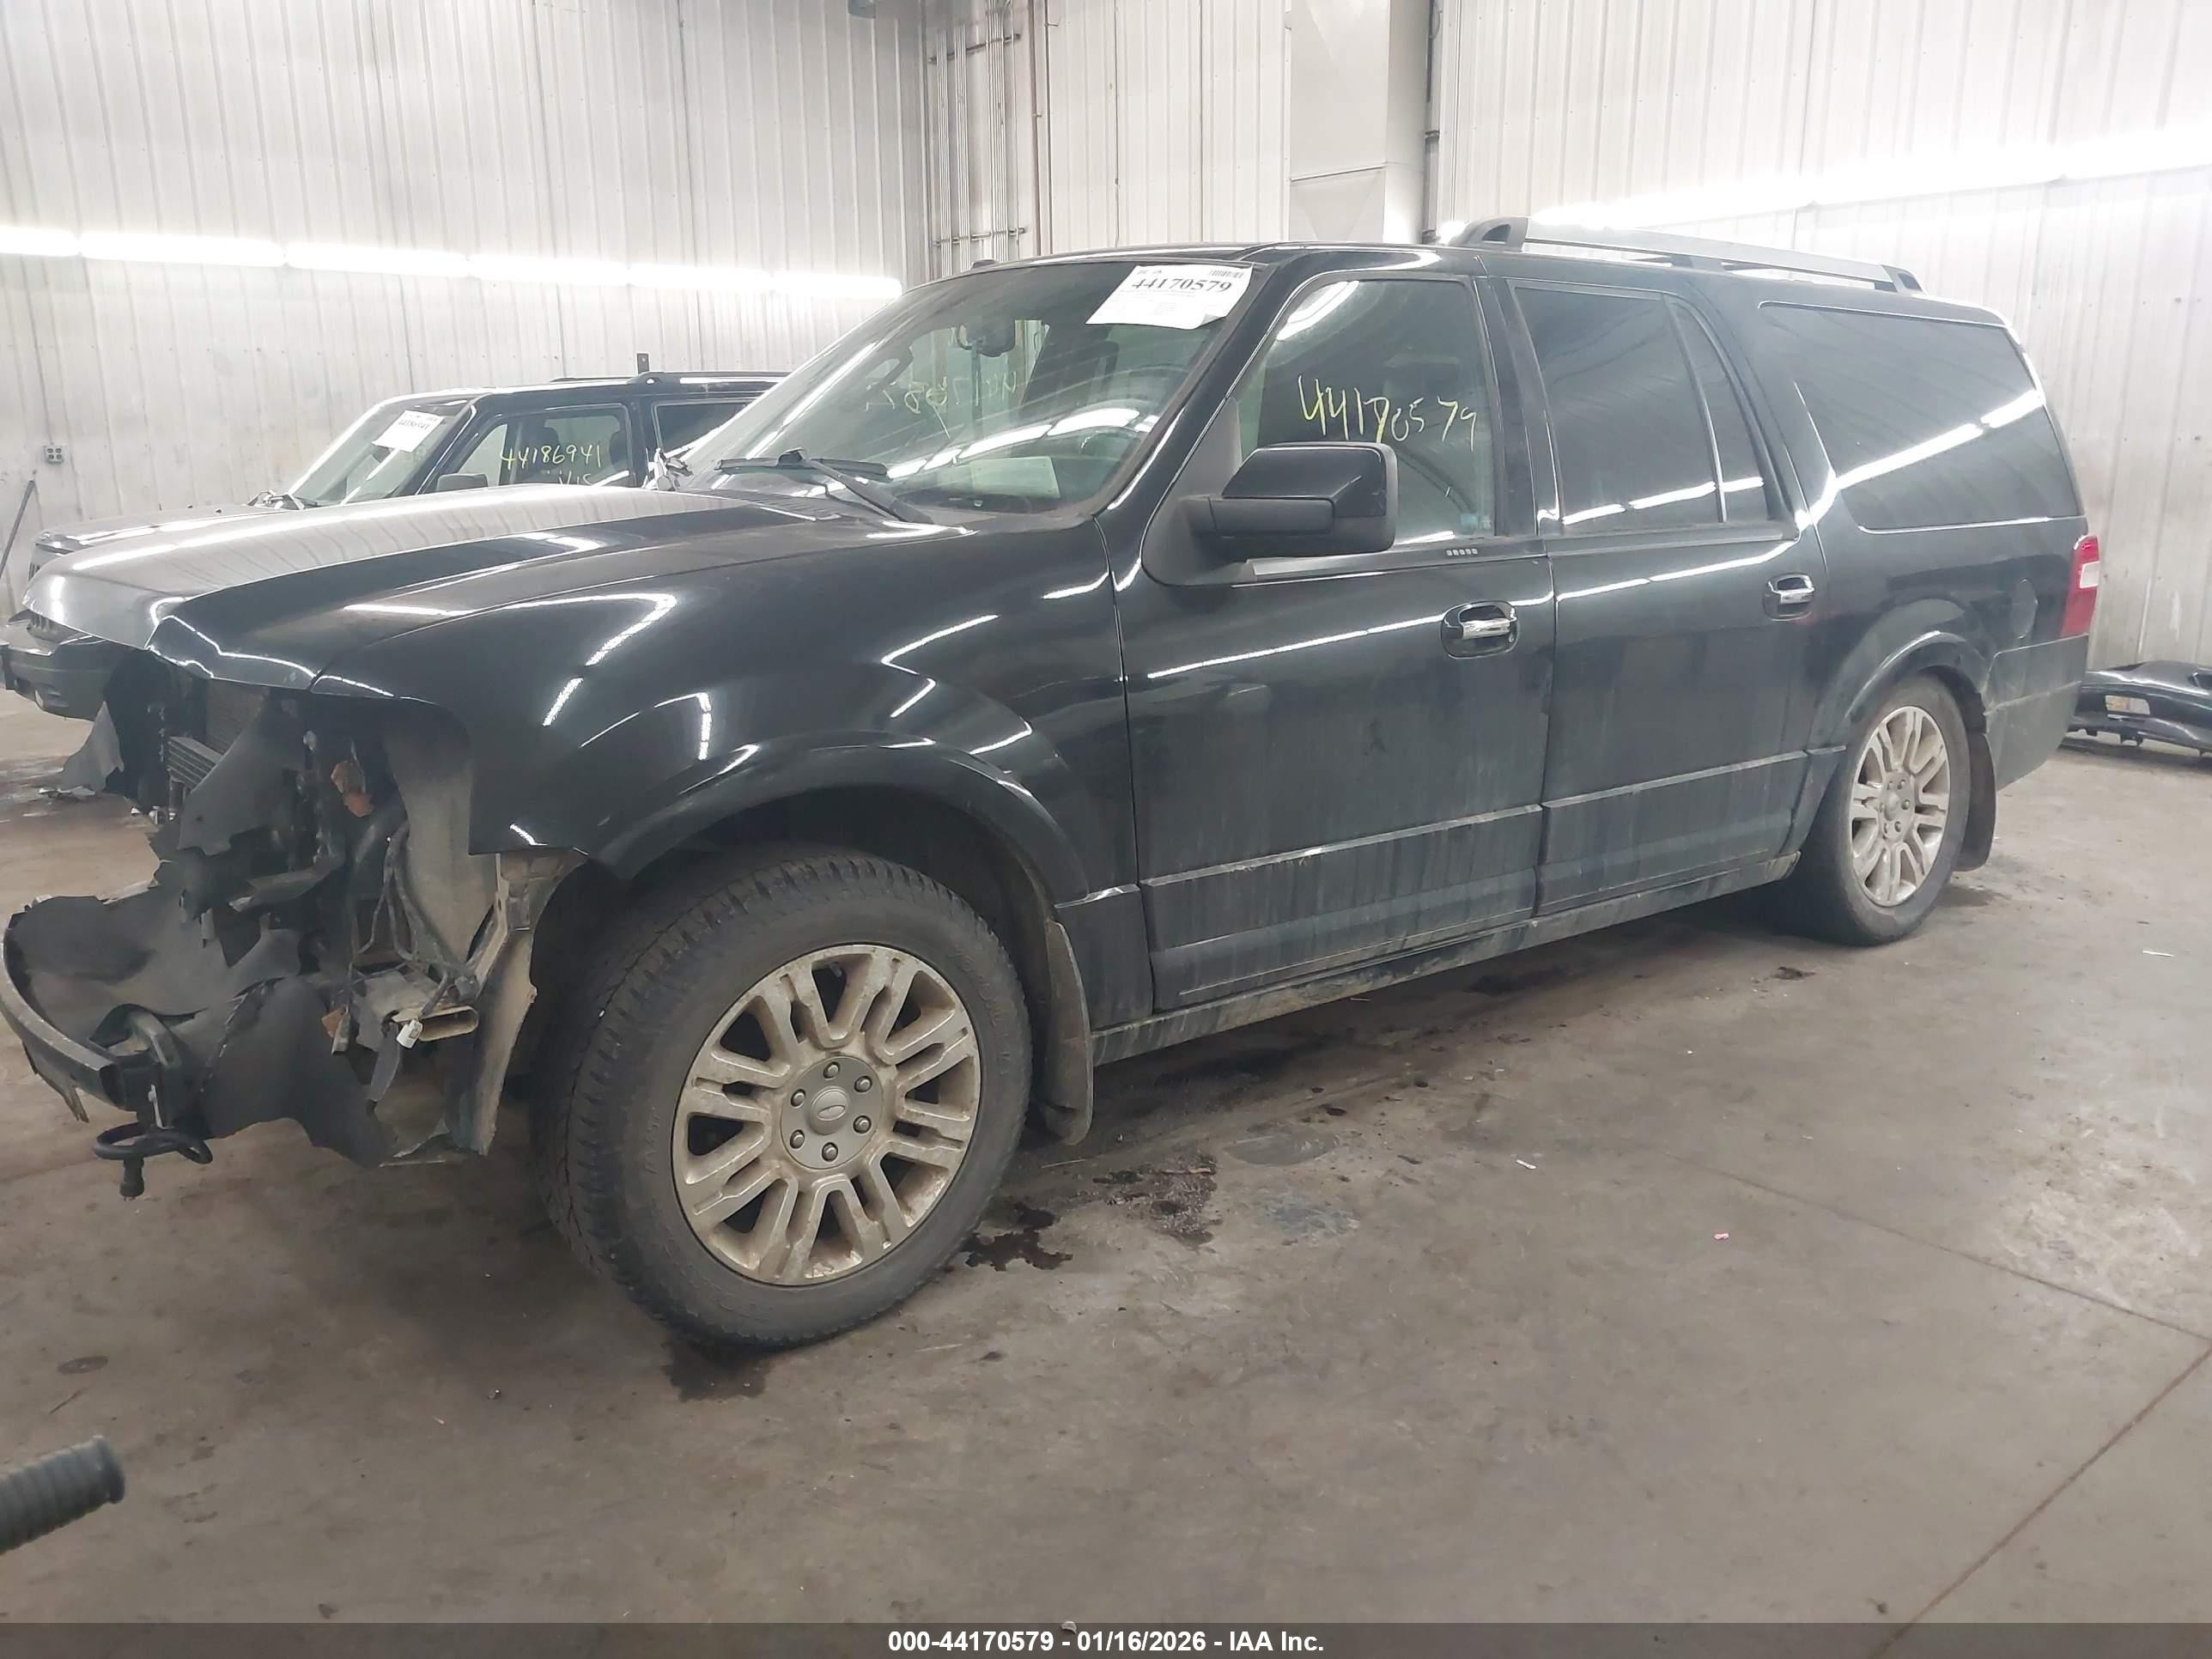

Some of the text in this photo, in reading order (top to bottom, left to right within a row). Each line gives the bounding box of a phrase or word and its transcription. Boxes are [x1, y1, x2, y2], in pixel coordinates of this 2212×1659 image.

[1132, 278, 1232, 292] 44170579
[1297, 374, 1477, 453] 44170579
[500, 444, 601, 471] 44186941
